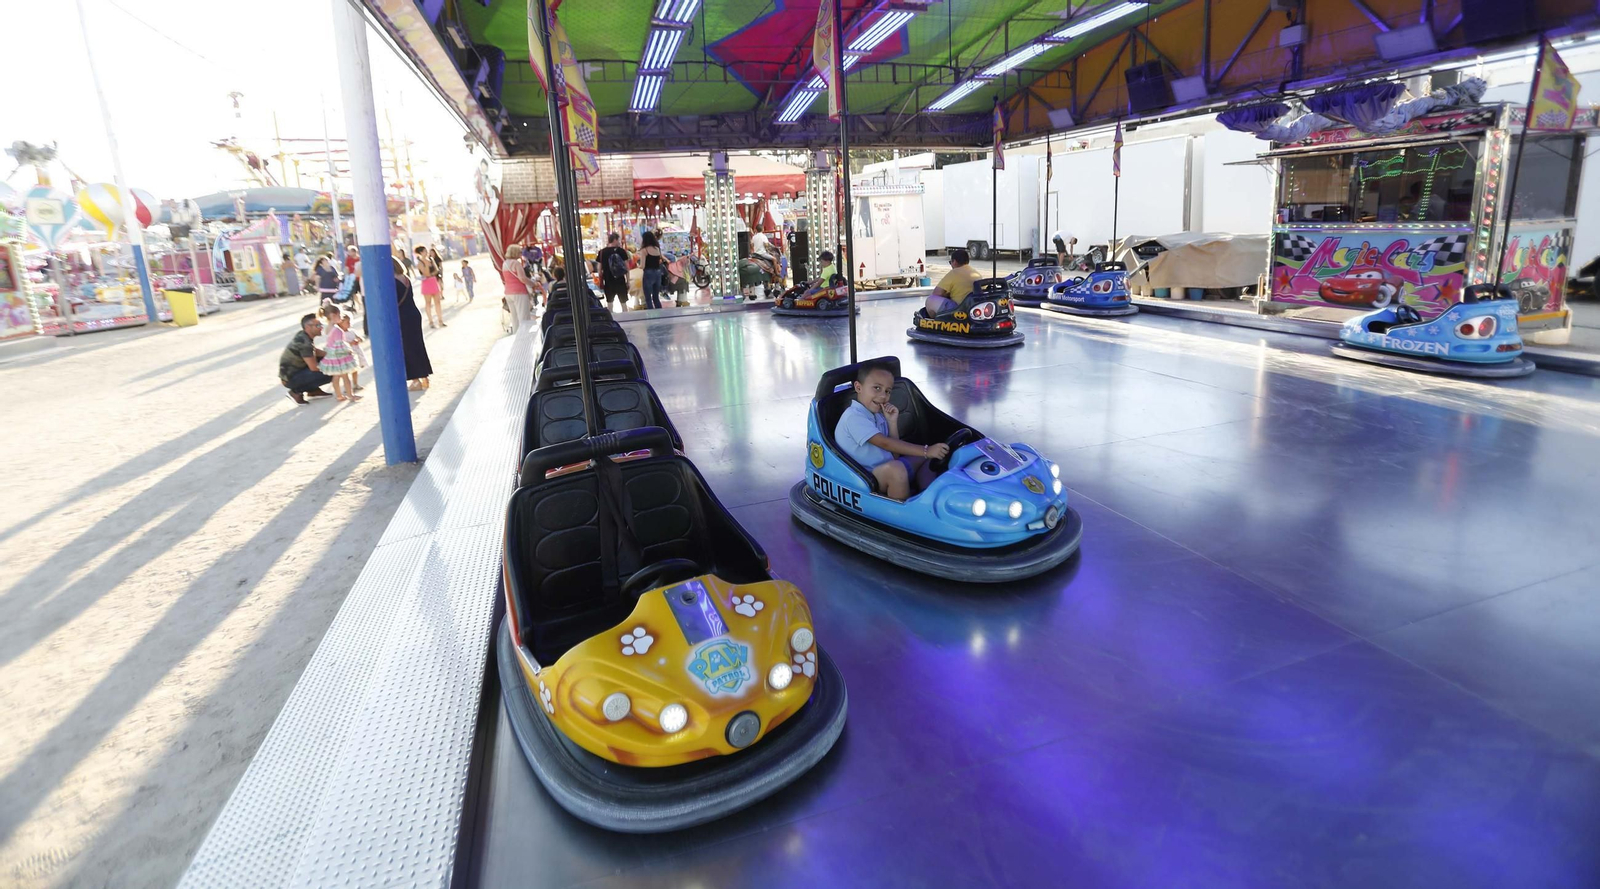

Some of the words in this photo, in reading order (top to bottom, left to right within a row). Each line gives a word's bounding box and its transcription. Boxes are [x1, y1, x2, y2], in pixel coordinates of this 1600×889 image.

[1294, 237, 1379, 278] Magic
[1380, 239, 1437, 285] Cars
[919, 319, 970, 334] BATMAN
[1382, 336, 1450, 355] FROZEN
[813, 472, 863, 512] POLICE
[688, 645, 748, 681] PAW
[711, 669, 747, 688] PATROL
